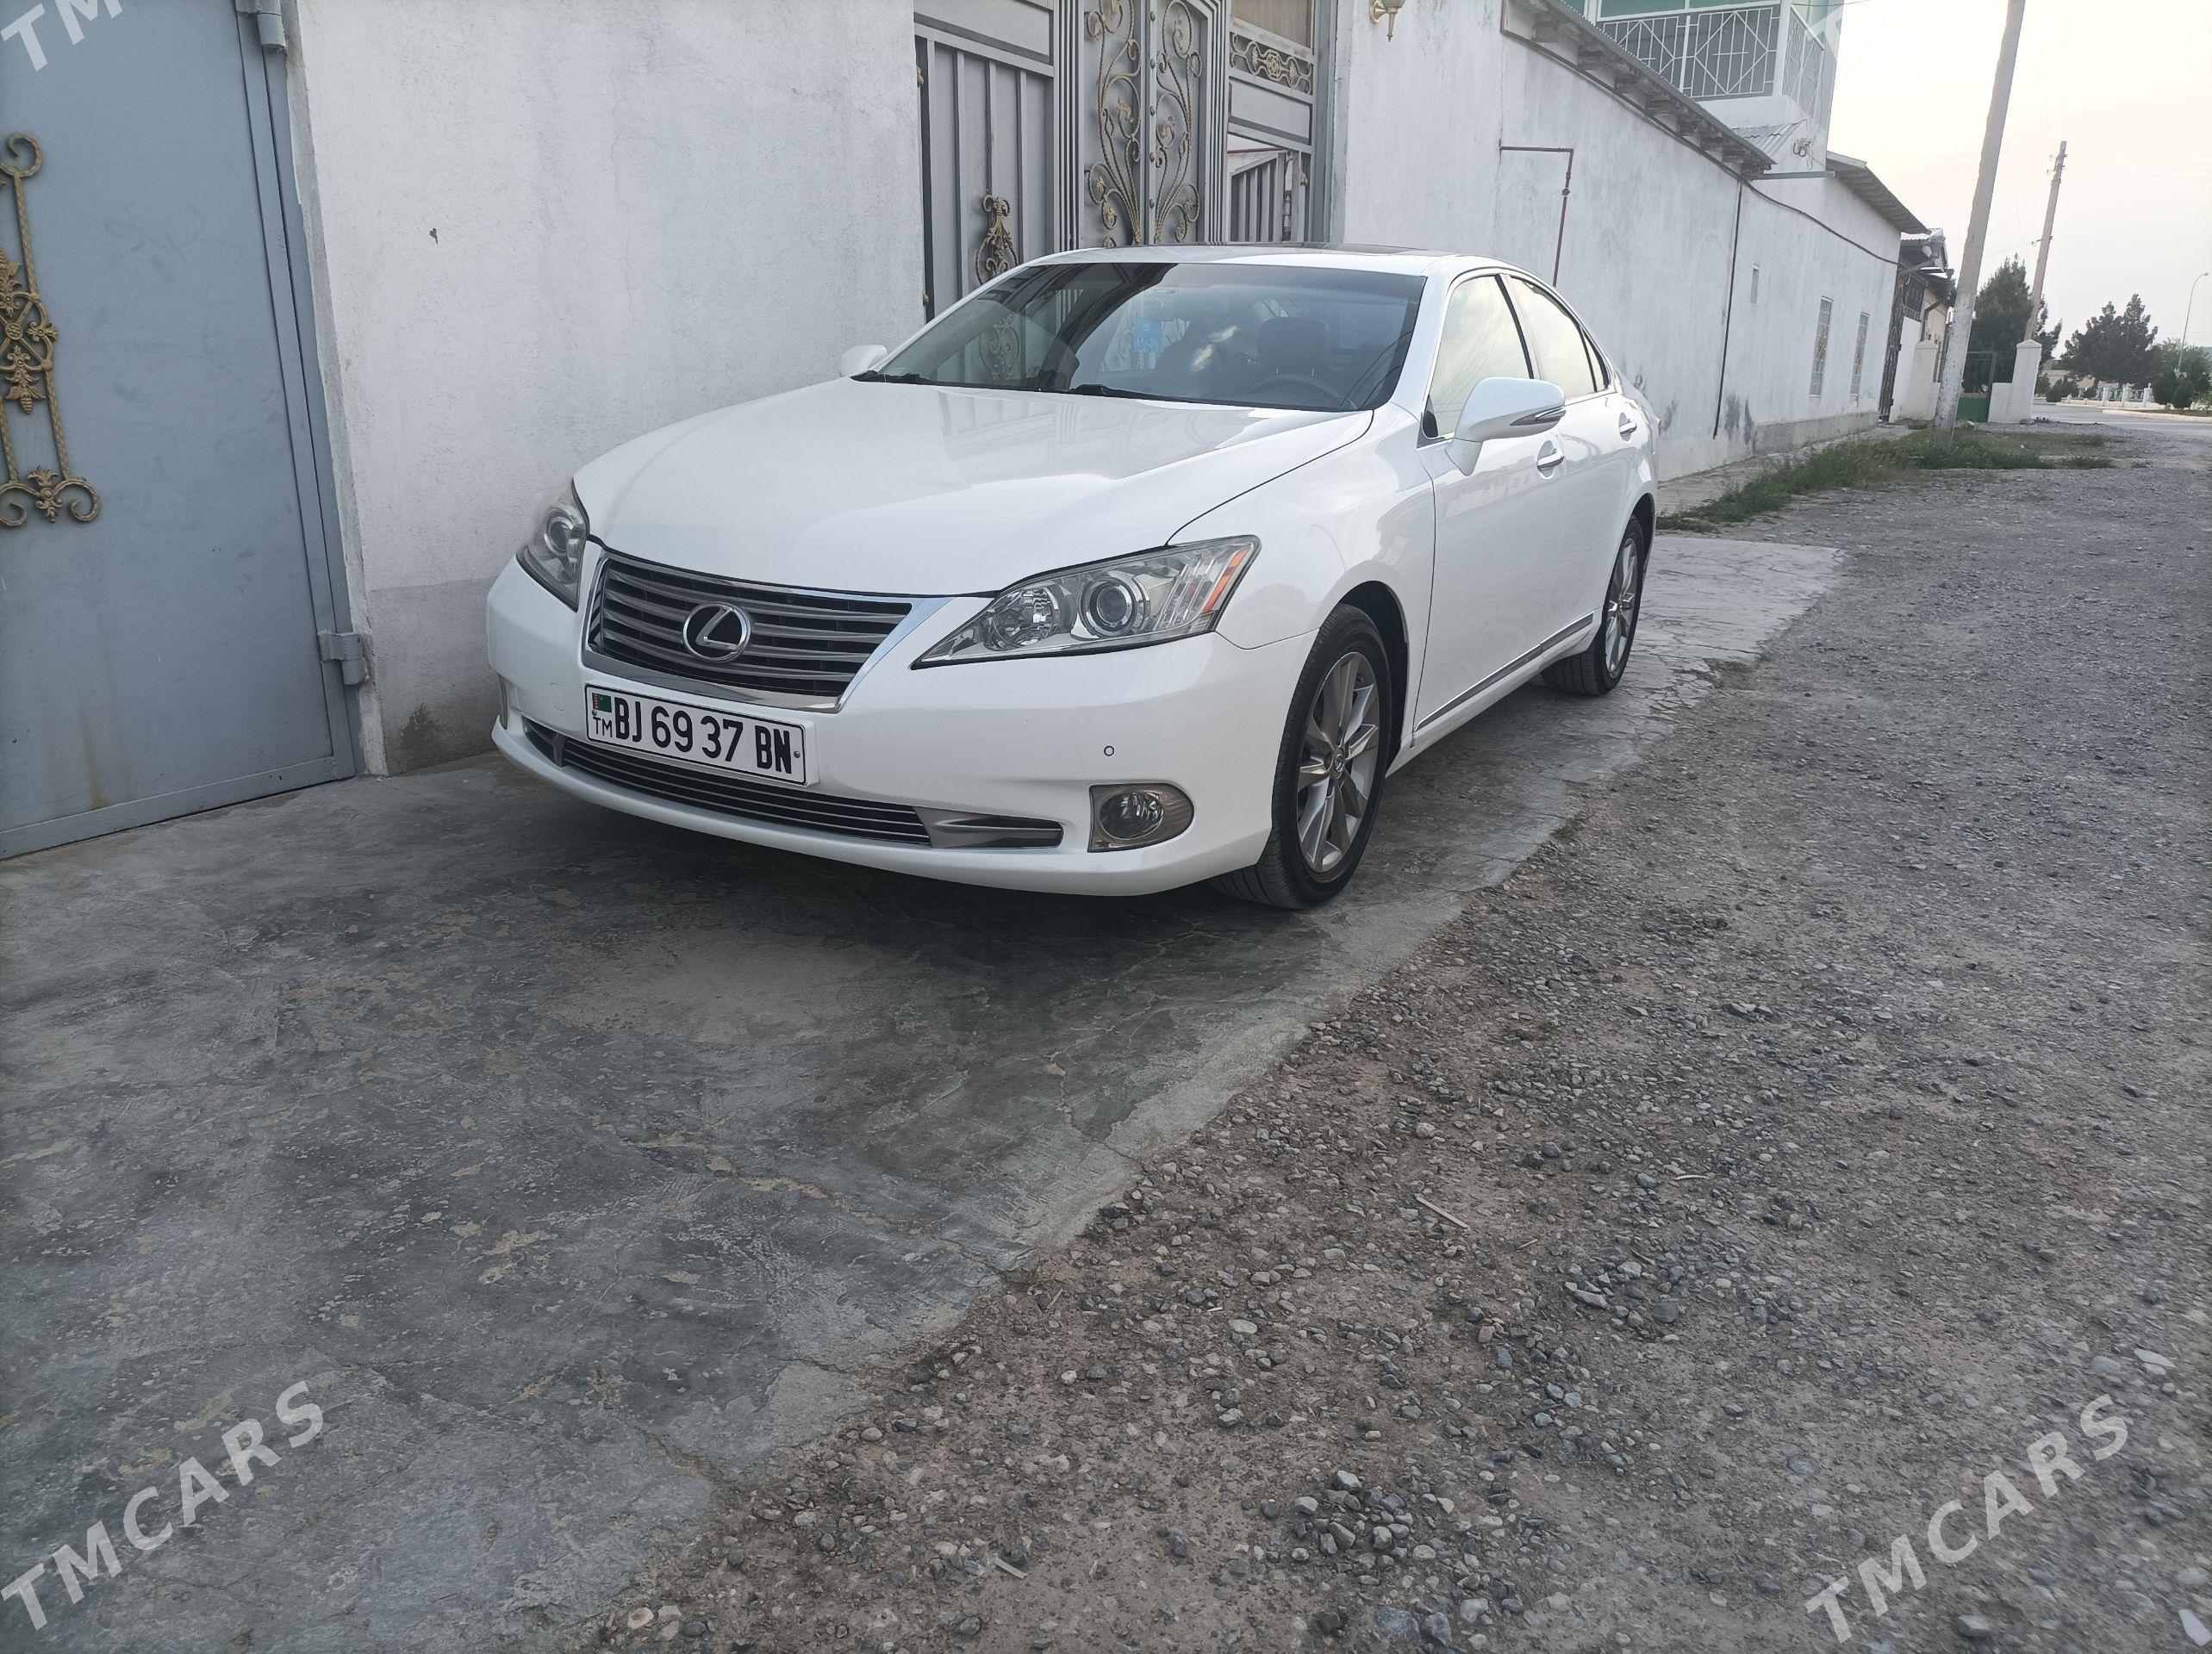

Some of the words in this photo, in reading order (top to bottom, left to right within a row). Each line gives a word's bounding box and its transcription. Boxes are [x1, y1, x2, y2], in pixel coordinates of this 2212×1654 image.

[592, 716, 613, 738] TM
[614, 697, 642, 743] BJ
[651, 706, 693, 753] 69
[701, 715, 744, 762] 37
[755, 725, 792, 774] BN
